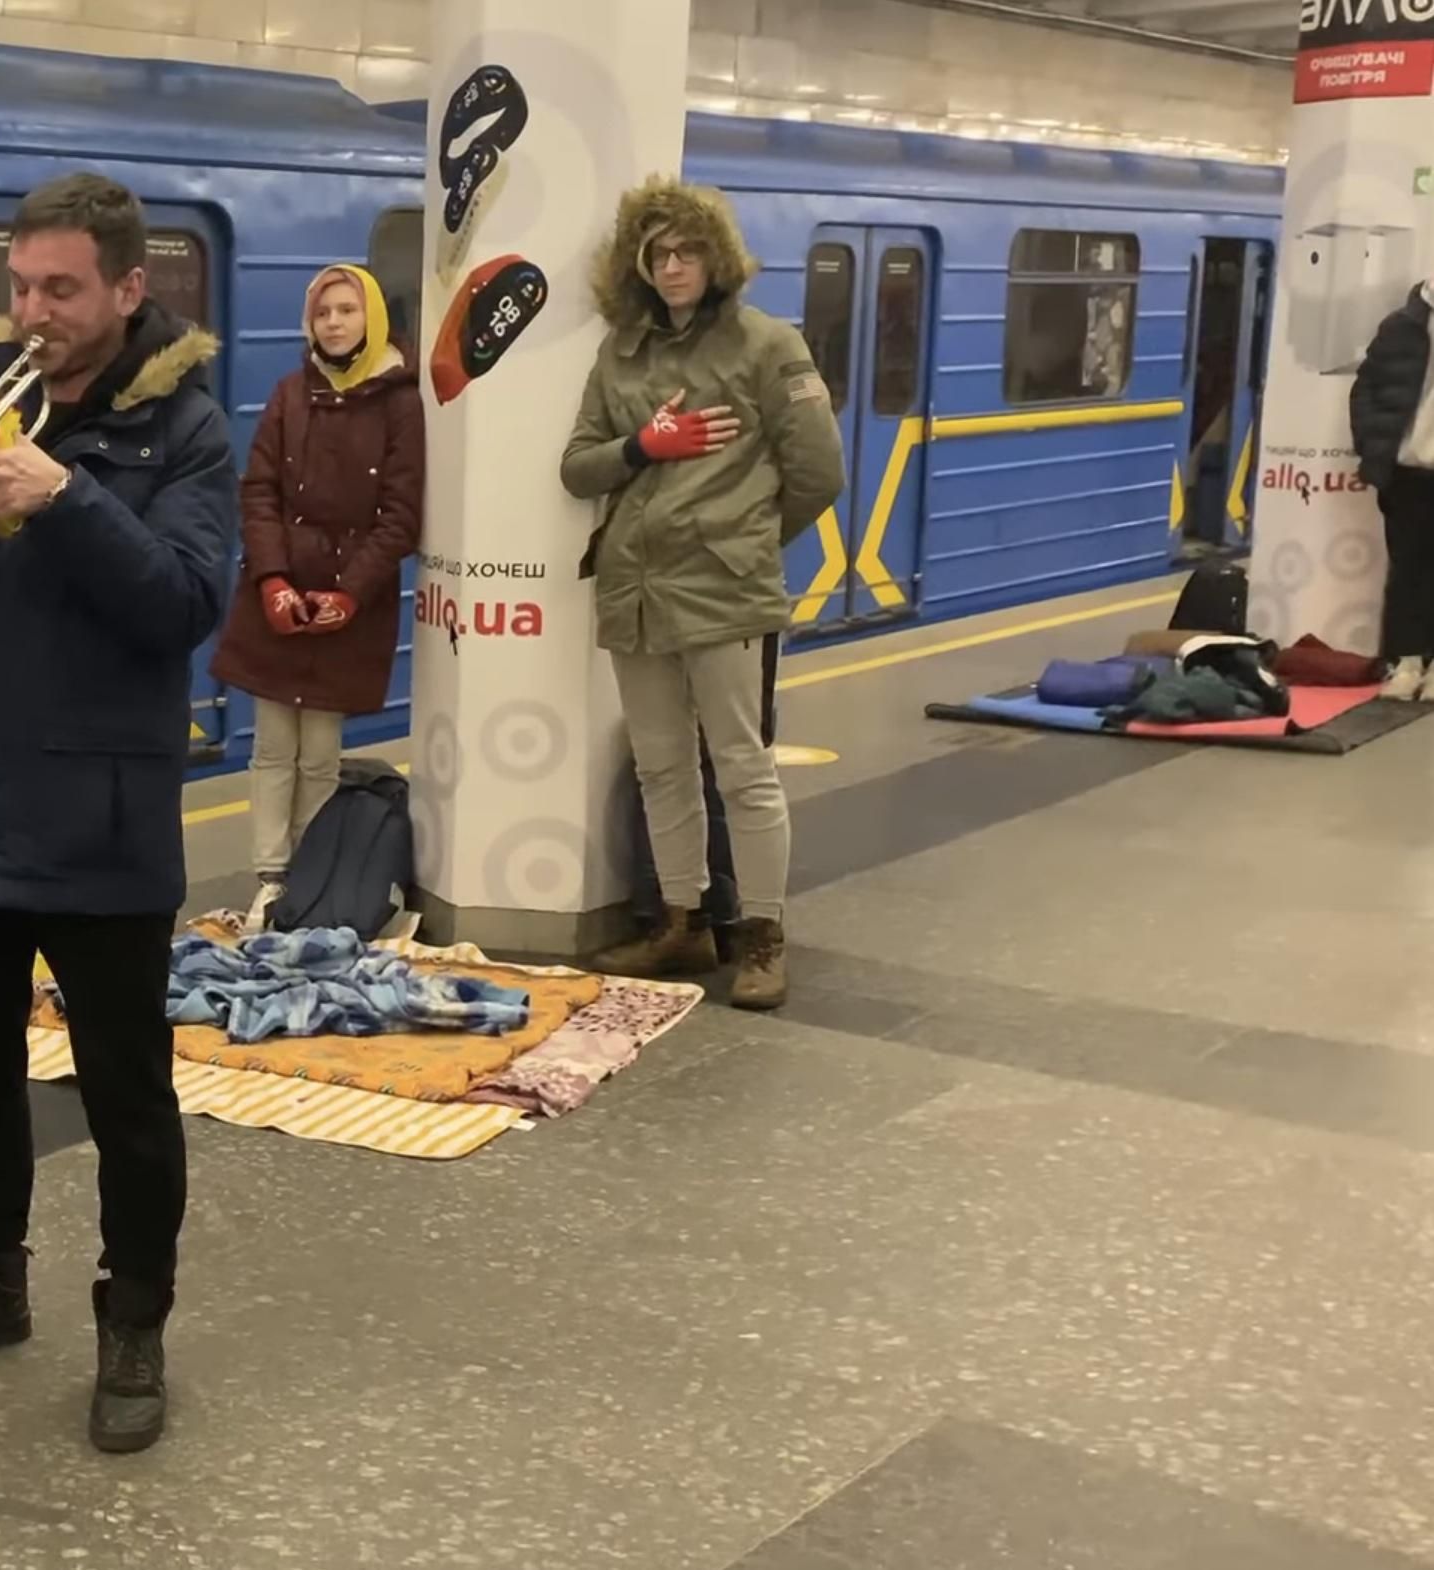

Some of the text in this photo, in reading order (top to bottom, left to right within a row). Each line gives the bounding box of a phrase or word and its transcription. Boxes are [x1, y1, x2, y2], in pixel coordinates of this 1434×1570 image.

[1319, 70, 1386, 88] ПОВІТРЯ
[498, 295, 521, 324] 08
[489, 311, 509, 337] 16
[1262, 463, 1368, 493] allo.ua
[466, 562, 545, 578] ХОЧЕШ
[414, 582, 543, 636] allo.ua
